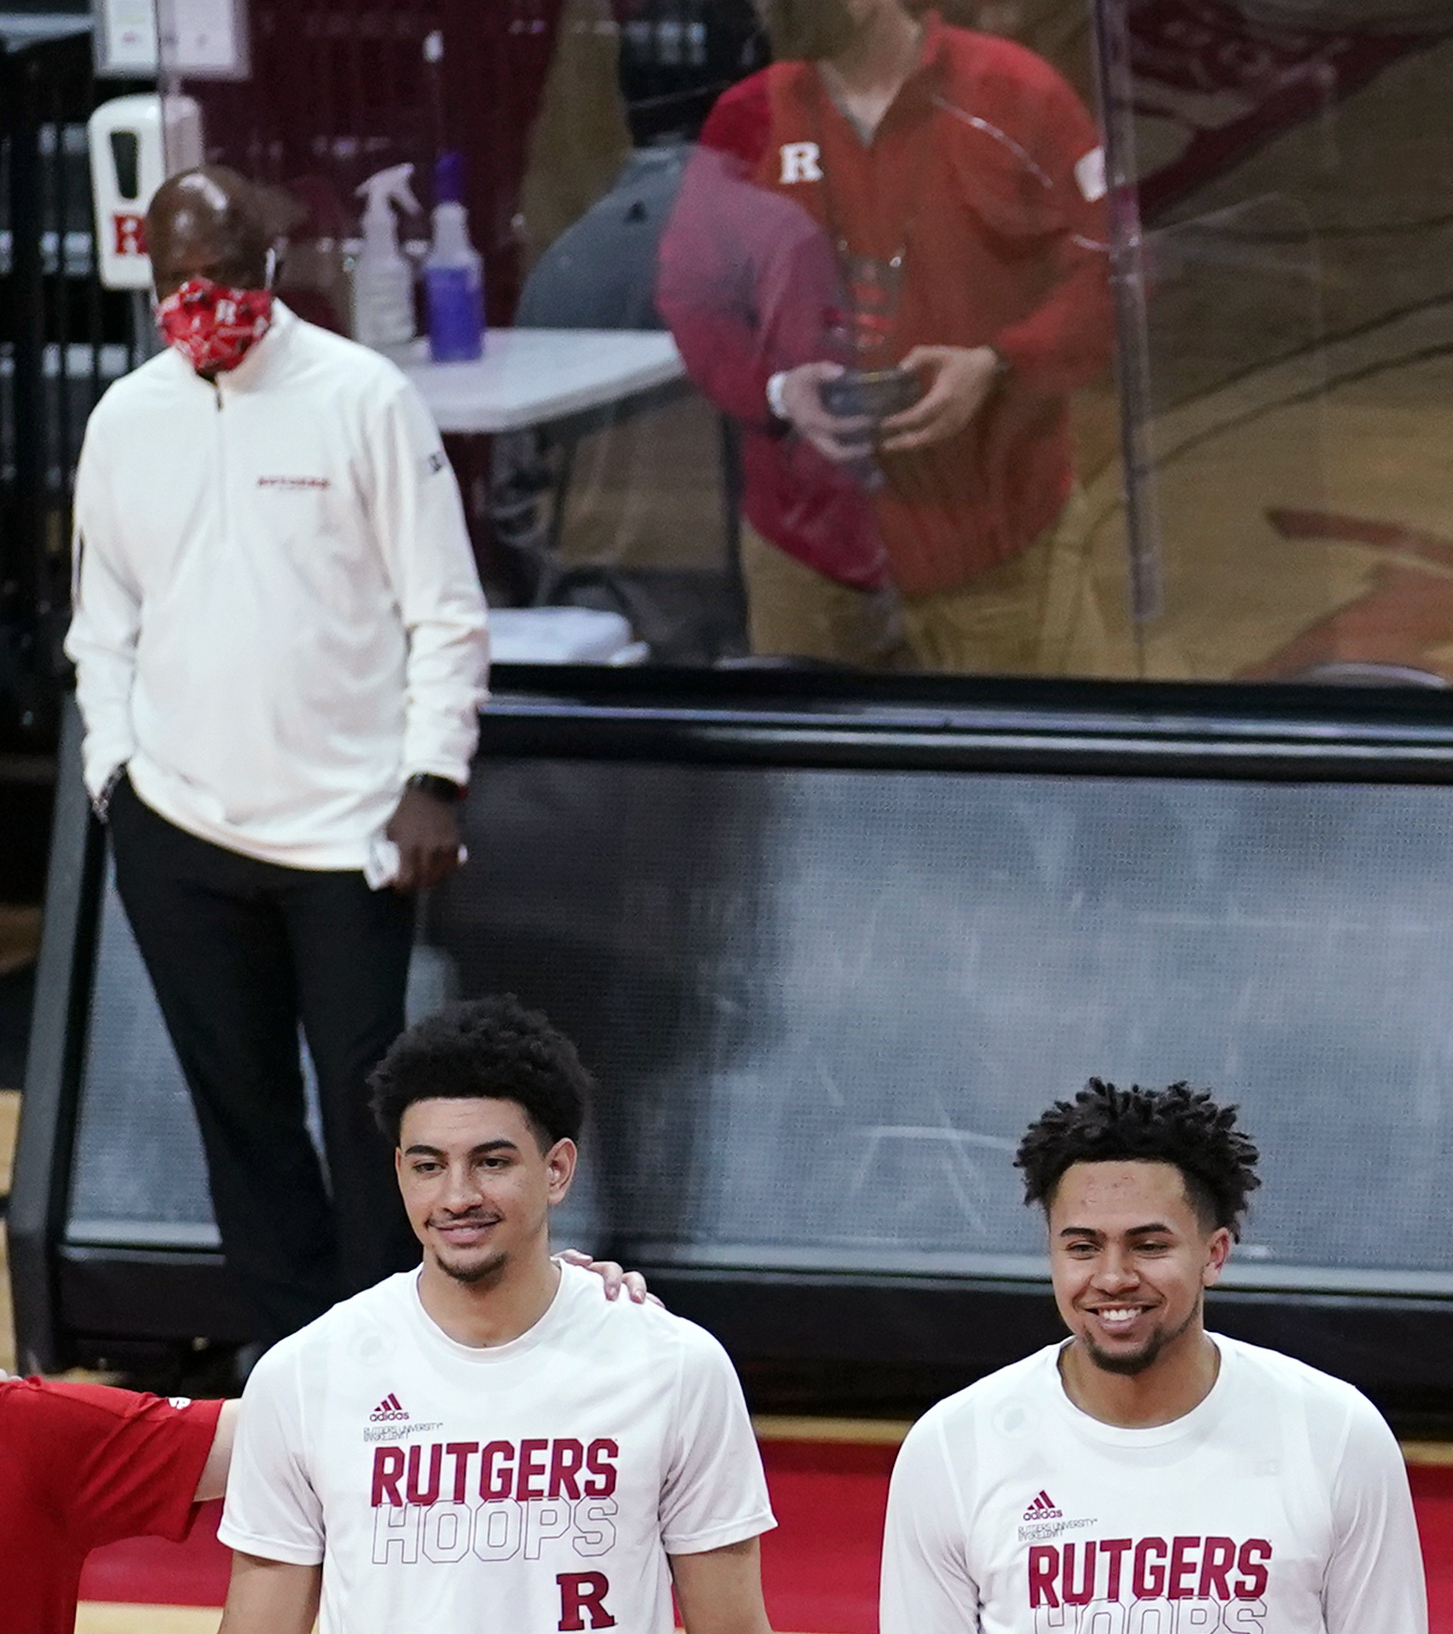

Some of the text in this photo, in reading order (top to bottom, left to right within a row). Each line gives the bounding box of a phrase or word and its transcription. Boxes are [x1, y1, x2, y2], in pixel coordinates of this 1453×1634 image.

[779, 143, 824, 183] R
[371, 1438, 619, 1508] RUTGERS
[372, 1496, 618, 1564] HOOPS
[1023, 1509, 1063, 1521] adidas
[556, 1571, 617, 1632] R
[1028, 1536, 1272, 1609] RUTGERS
